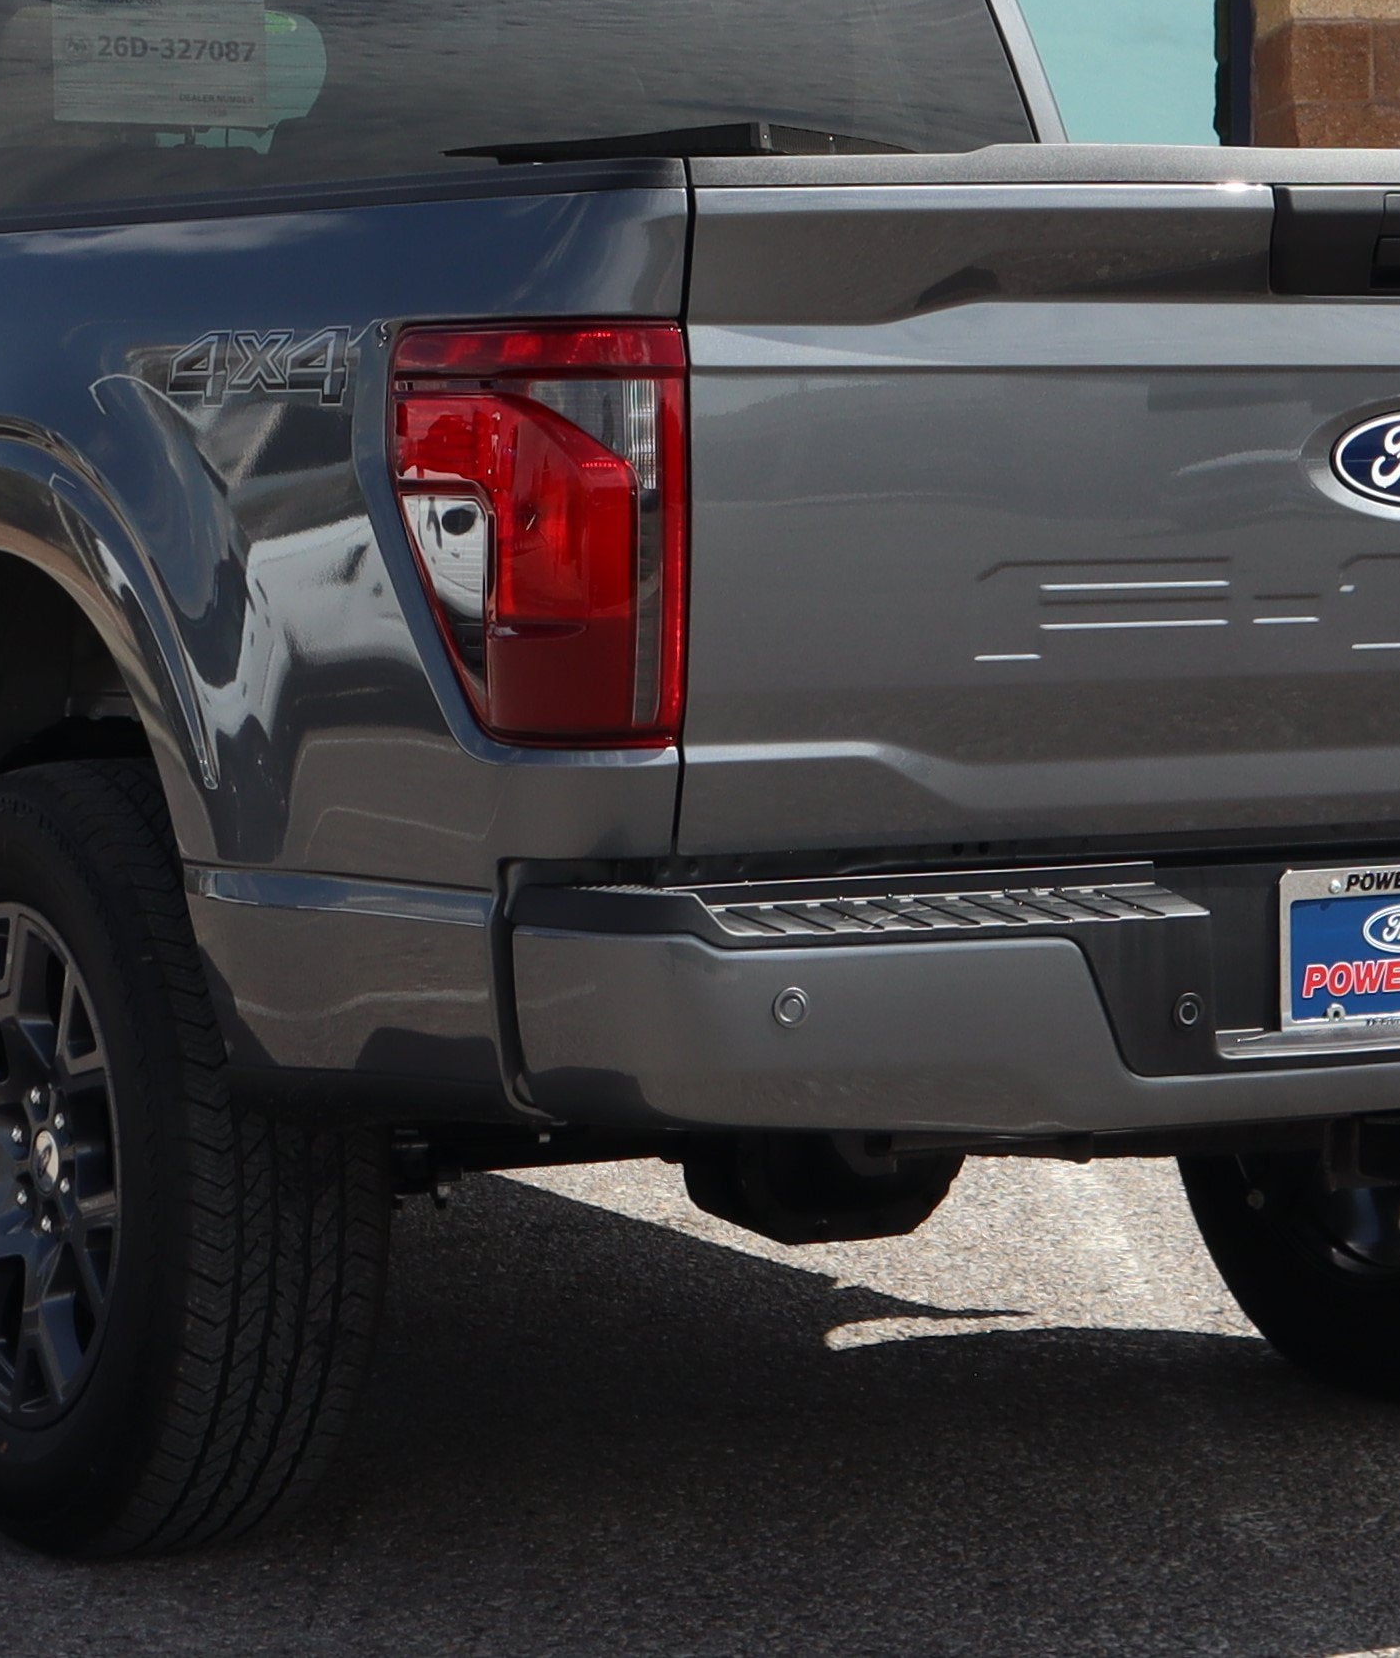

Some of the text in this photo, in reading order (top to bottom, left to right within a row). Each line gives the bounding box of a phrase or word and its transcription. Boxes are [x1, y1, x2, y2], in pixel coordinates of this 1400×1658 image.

[97, 35, 257, 63] 26D-327087
[179, 93, 255, 105] DEALER NUMBER
